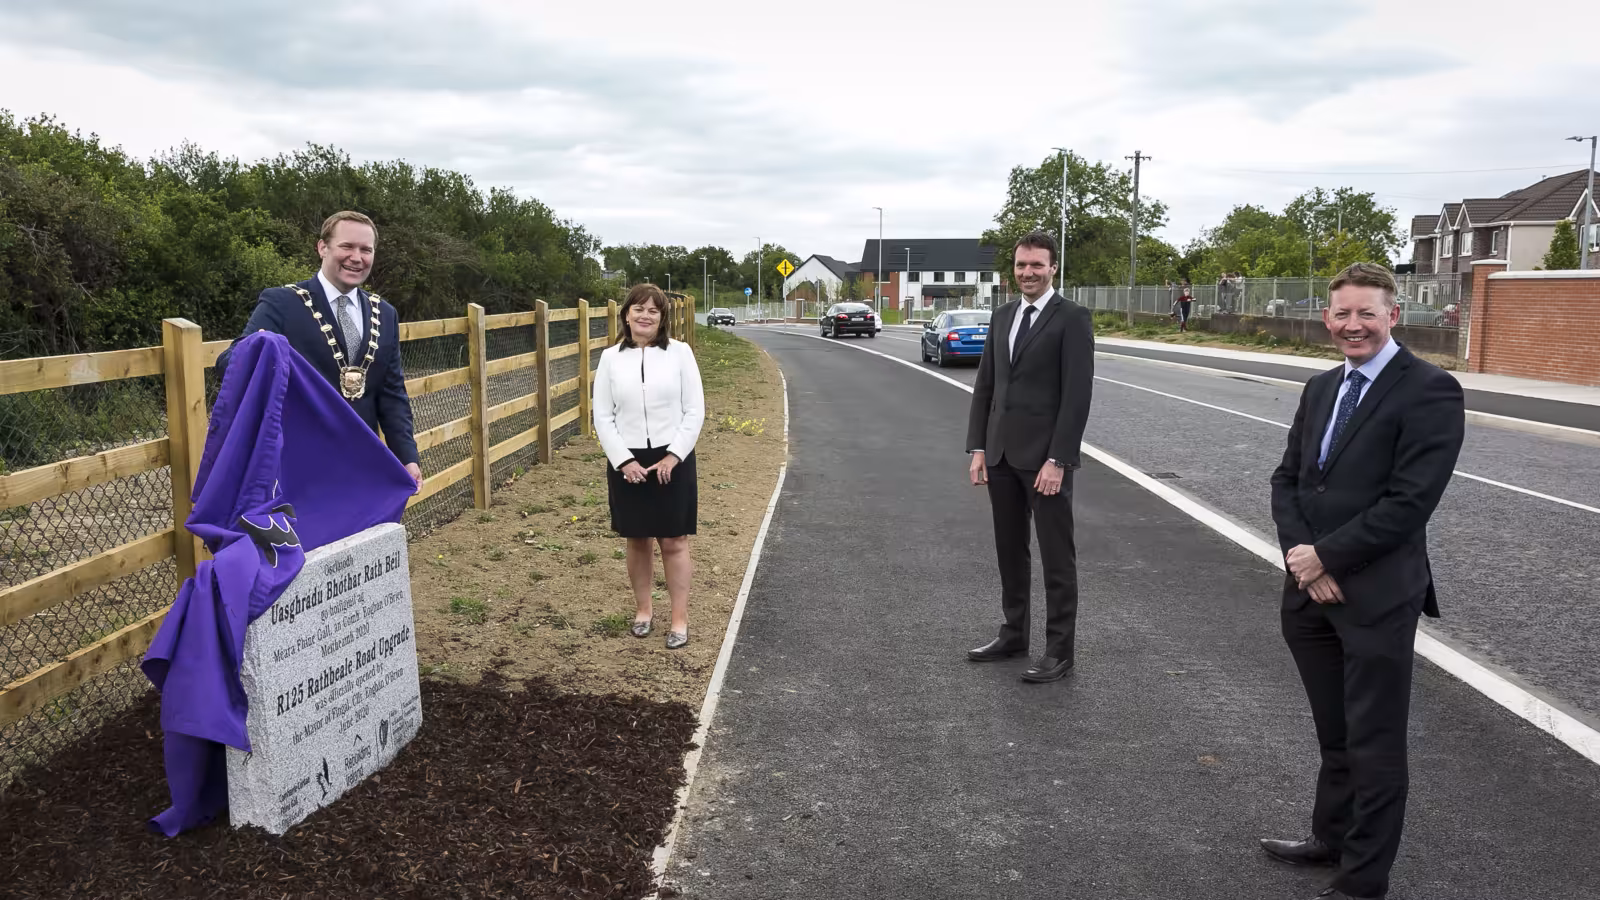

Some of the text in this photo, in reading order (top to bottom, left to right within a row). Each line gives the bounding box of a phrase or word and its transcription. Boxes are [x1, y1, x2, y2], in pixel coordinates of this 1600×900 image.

[326, 571, 362, 600] Bhóthar
[276, 624, 410, 716] R125 Rathbeale Road Upgrade
[314, 697, 328, 711] was
[355, 664, 376, 687] opened
[376, 662, 384, 675] by
[292, 731, 303, 746] the
[303, 717, 324, 738] Mayor
[324, 711, 332, 724] of
[338, 719, 354, 735] June
